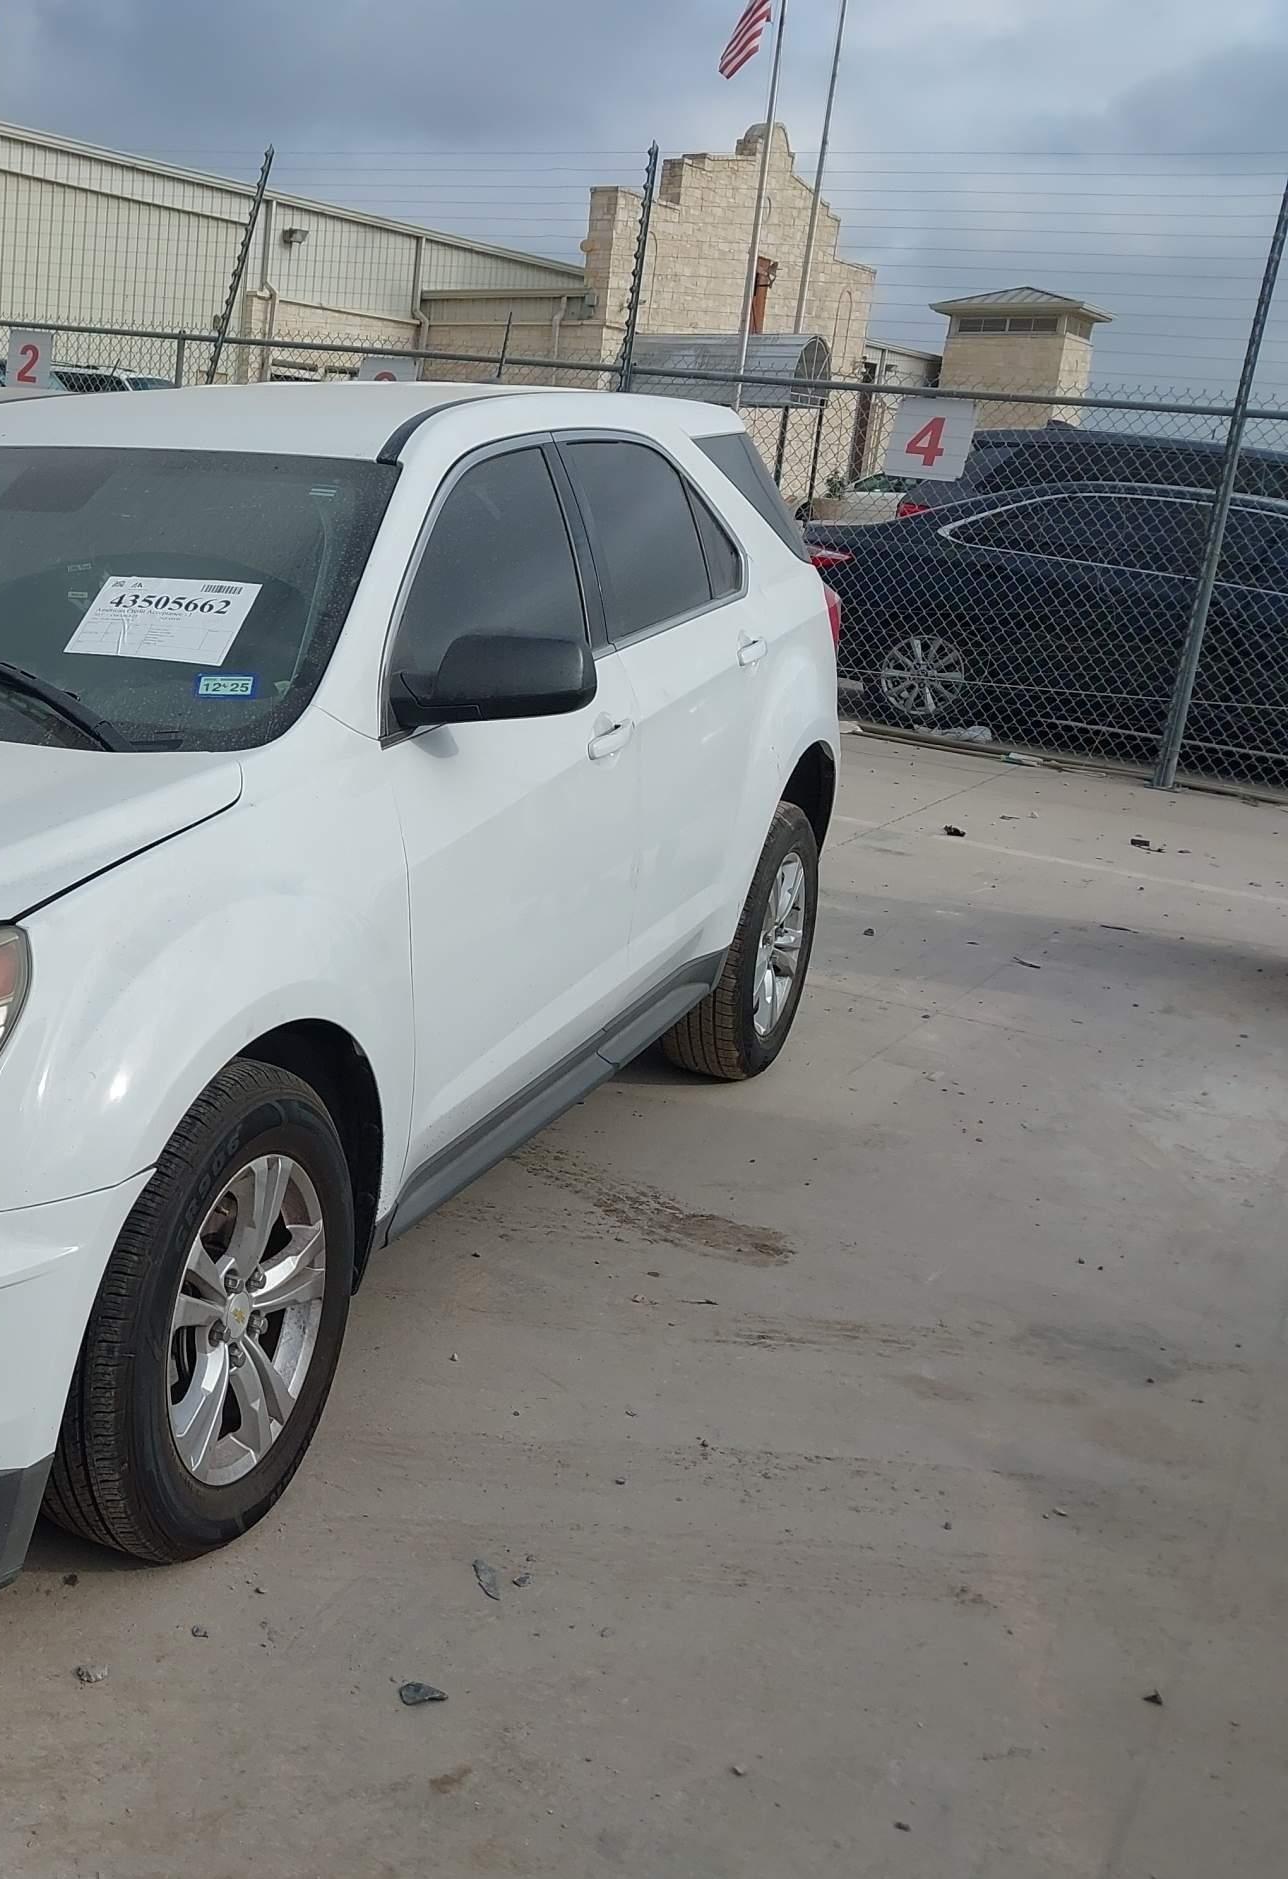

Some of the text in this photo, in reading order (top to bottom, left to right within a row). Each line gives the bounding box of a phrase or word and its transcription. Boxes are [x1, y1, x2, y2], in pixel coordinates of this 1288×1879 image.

[17, 344, 39, 383] 2
[905, 416, 946, 467] 4
[110, 593, 232, 615] 43505662
[203, 682, 250, 692] 12 25
